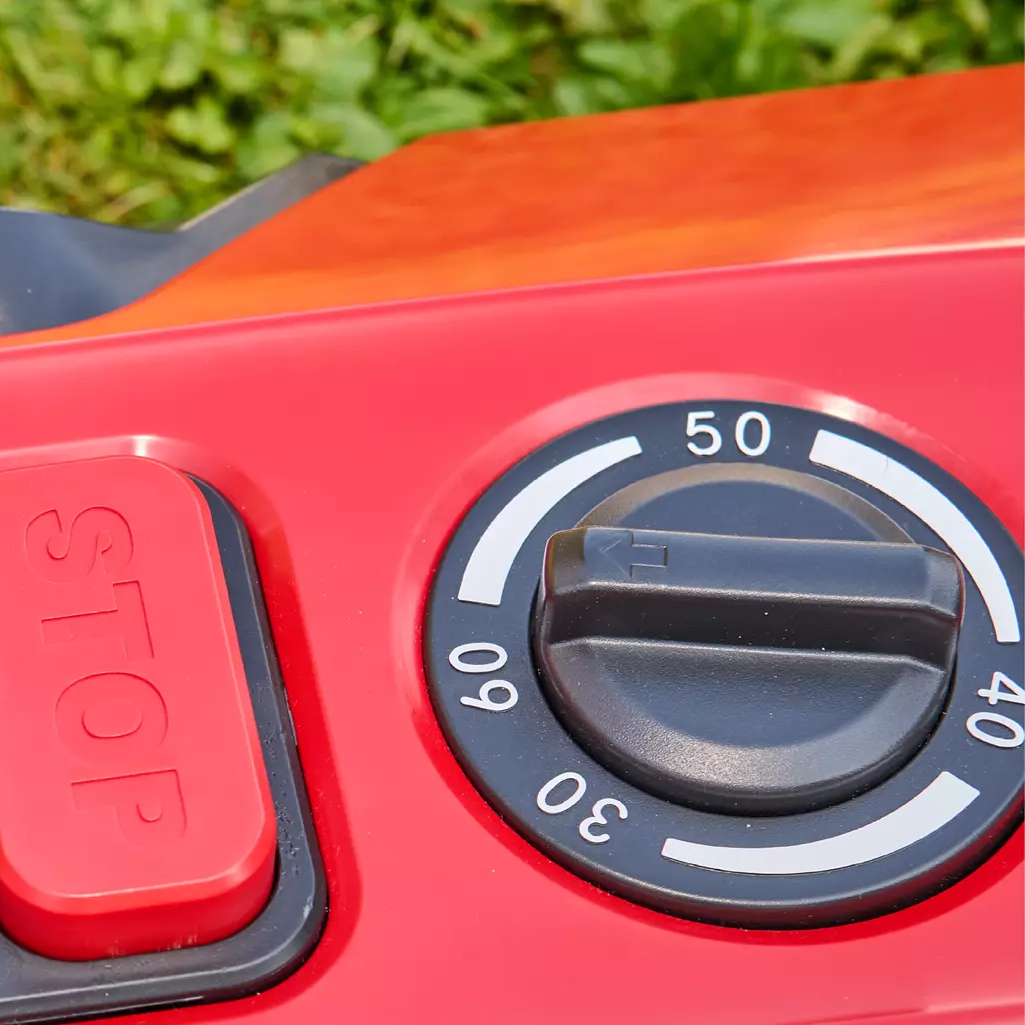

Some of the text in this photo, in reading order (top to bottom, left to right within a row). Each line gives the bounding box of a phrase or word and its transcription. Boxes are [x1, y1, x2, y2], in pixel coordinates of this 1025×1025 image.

[686, 411, 771, 457] 50
[25, 505, 188, 848] STOP
[448, 642, 519, 712] 60
[966, 671, 1025, 748] 40
[536, 771, 628, 843] 30
